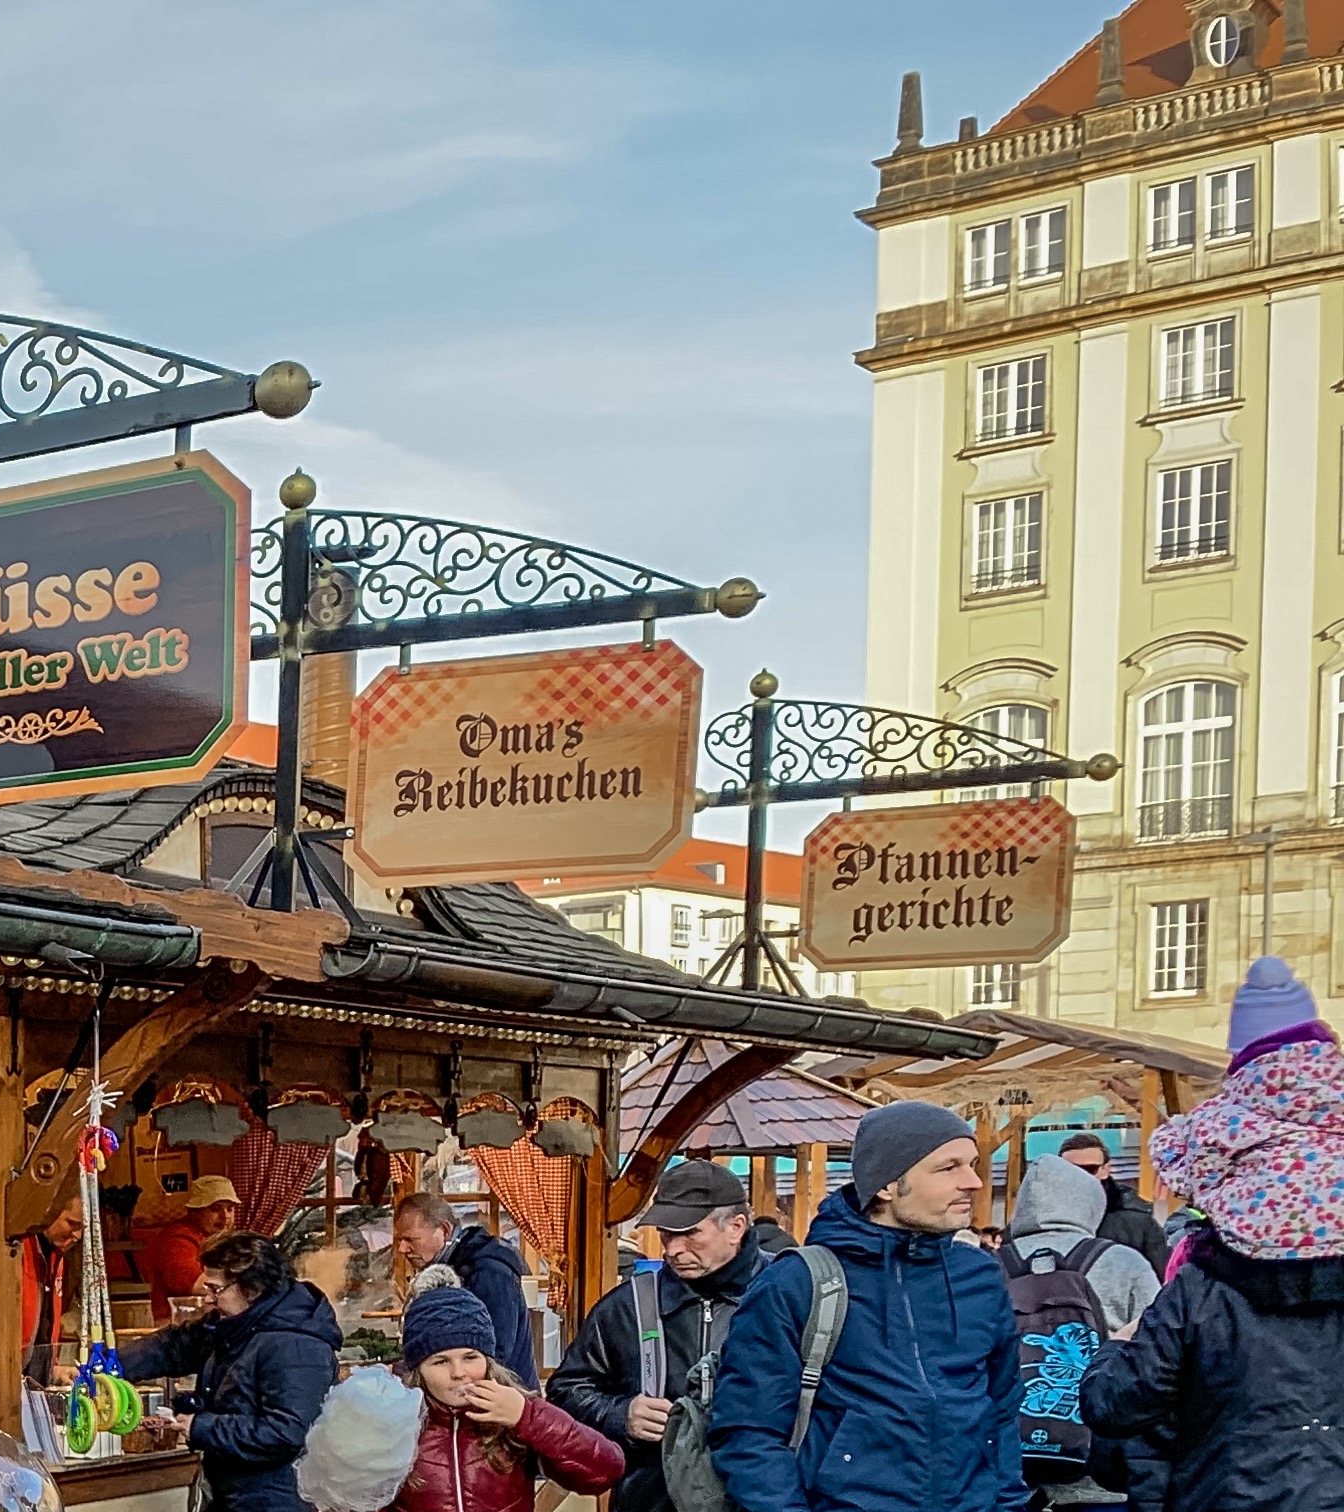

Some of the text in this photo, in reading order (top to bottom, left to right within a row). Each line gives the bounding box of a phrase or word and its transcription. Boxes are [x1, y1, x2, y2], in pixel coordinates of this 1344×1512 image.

[79, 627, 190, 684] Welt
[456, 713, 585, 759] Oma's
[393, 758, 643, 818] Reibekuchen
[833, 842, 1043, 890] Pfannen-
[849, 888, 1014, 946] gerichte
